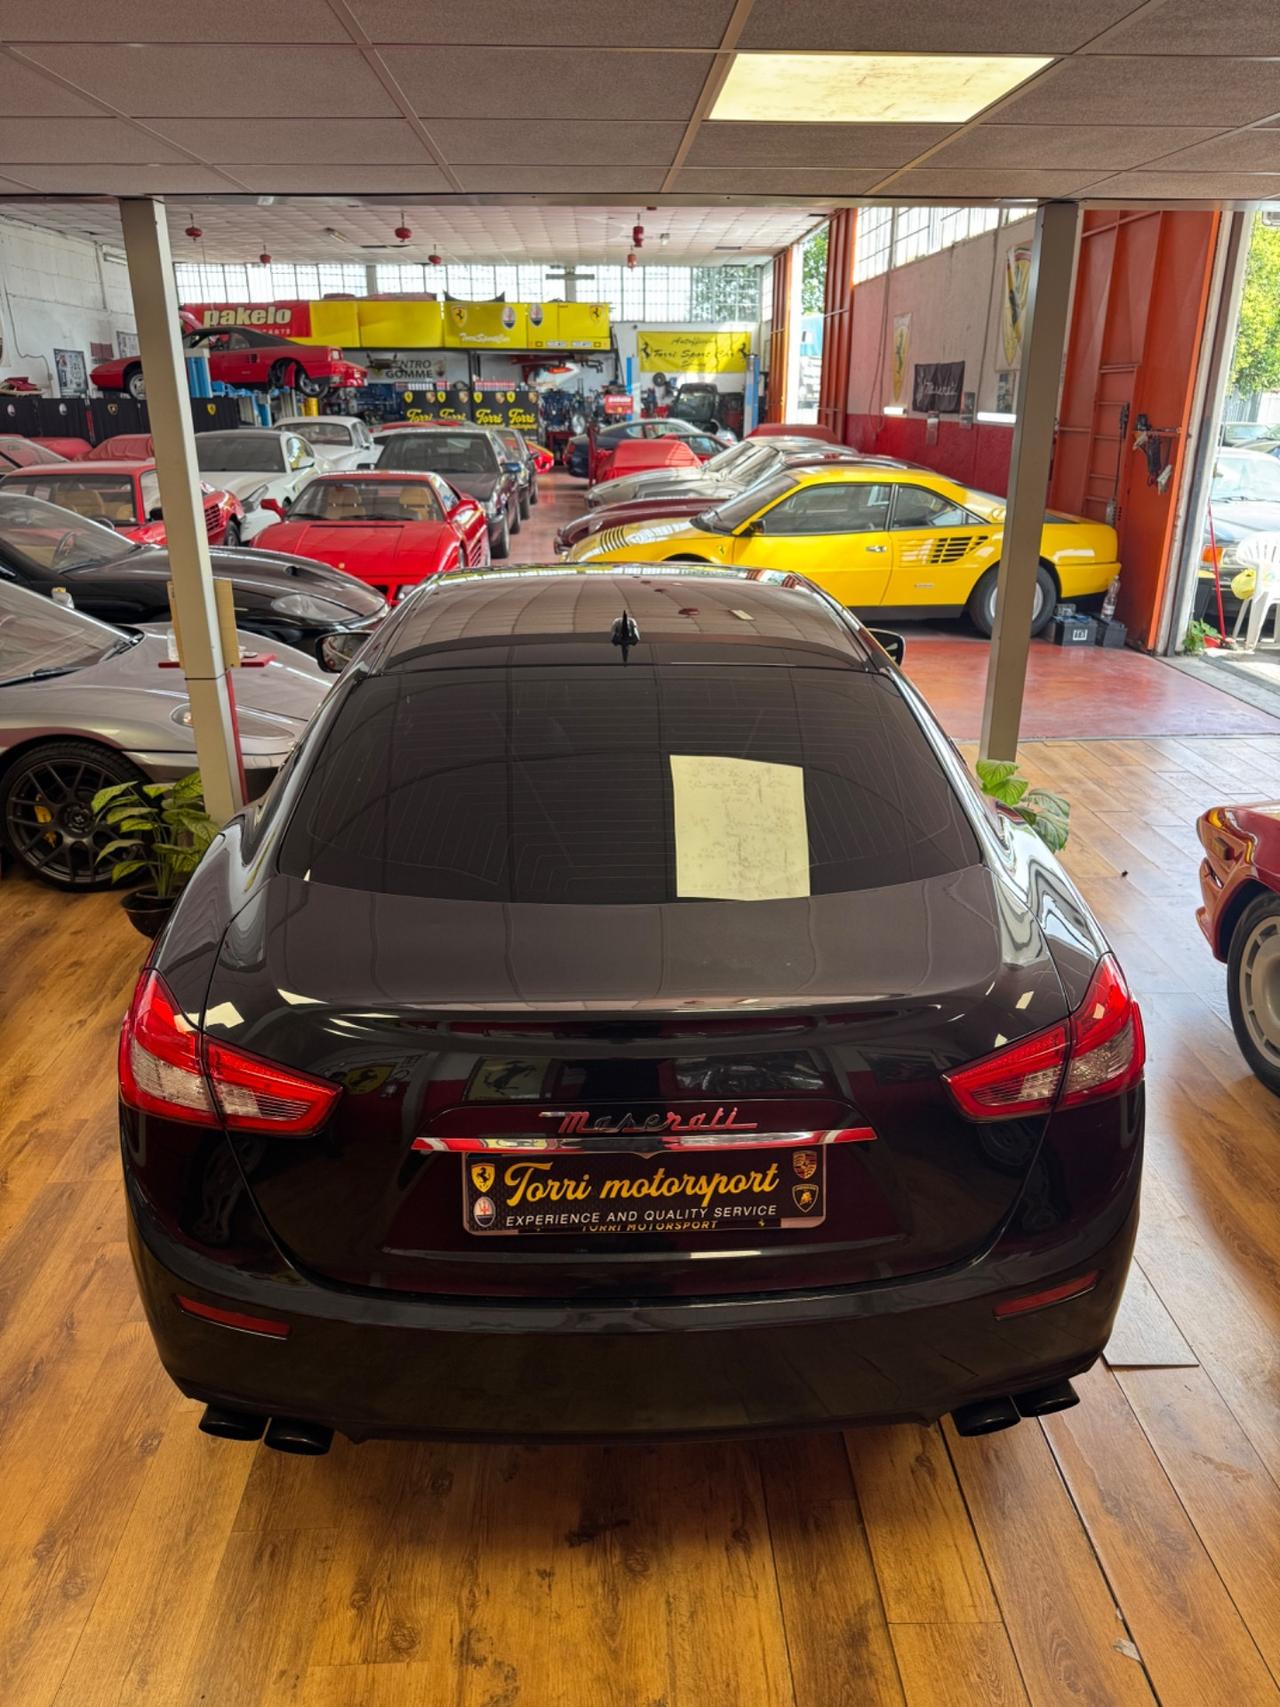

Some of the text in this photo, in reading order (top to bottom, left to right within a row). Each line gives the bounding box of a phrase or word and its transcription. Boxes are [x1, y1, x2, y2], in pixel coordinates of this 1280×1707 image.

[203, 306, 292, 328] pakelo
[385, 369, 433, 379] GOMME
[475, 408, 503, 425] Torri
[508, 408, 536, 425] Torri
[539, 1107, 758, 1134] Maserati
[504, 1161, 780, 1207] Torri motorsport
[506, 1205, 777, 1227] EXPERIENCE AND QUALITY SERVICE
